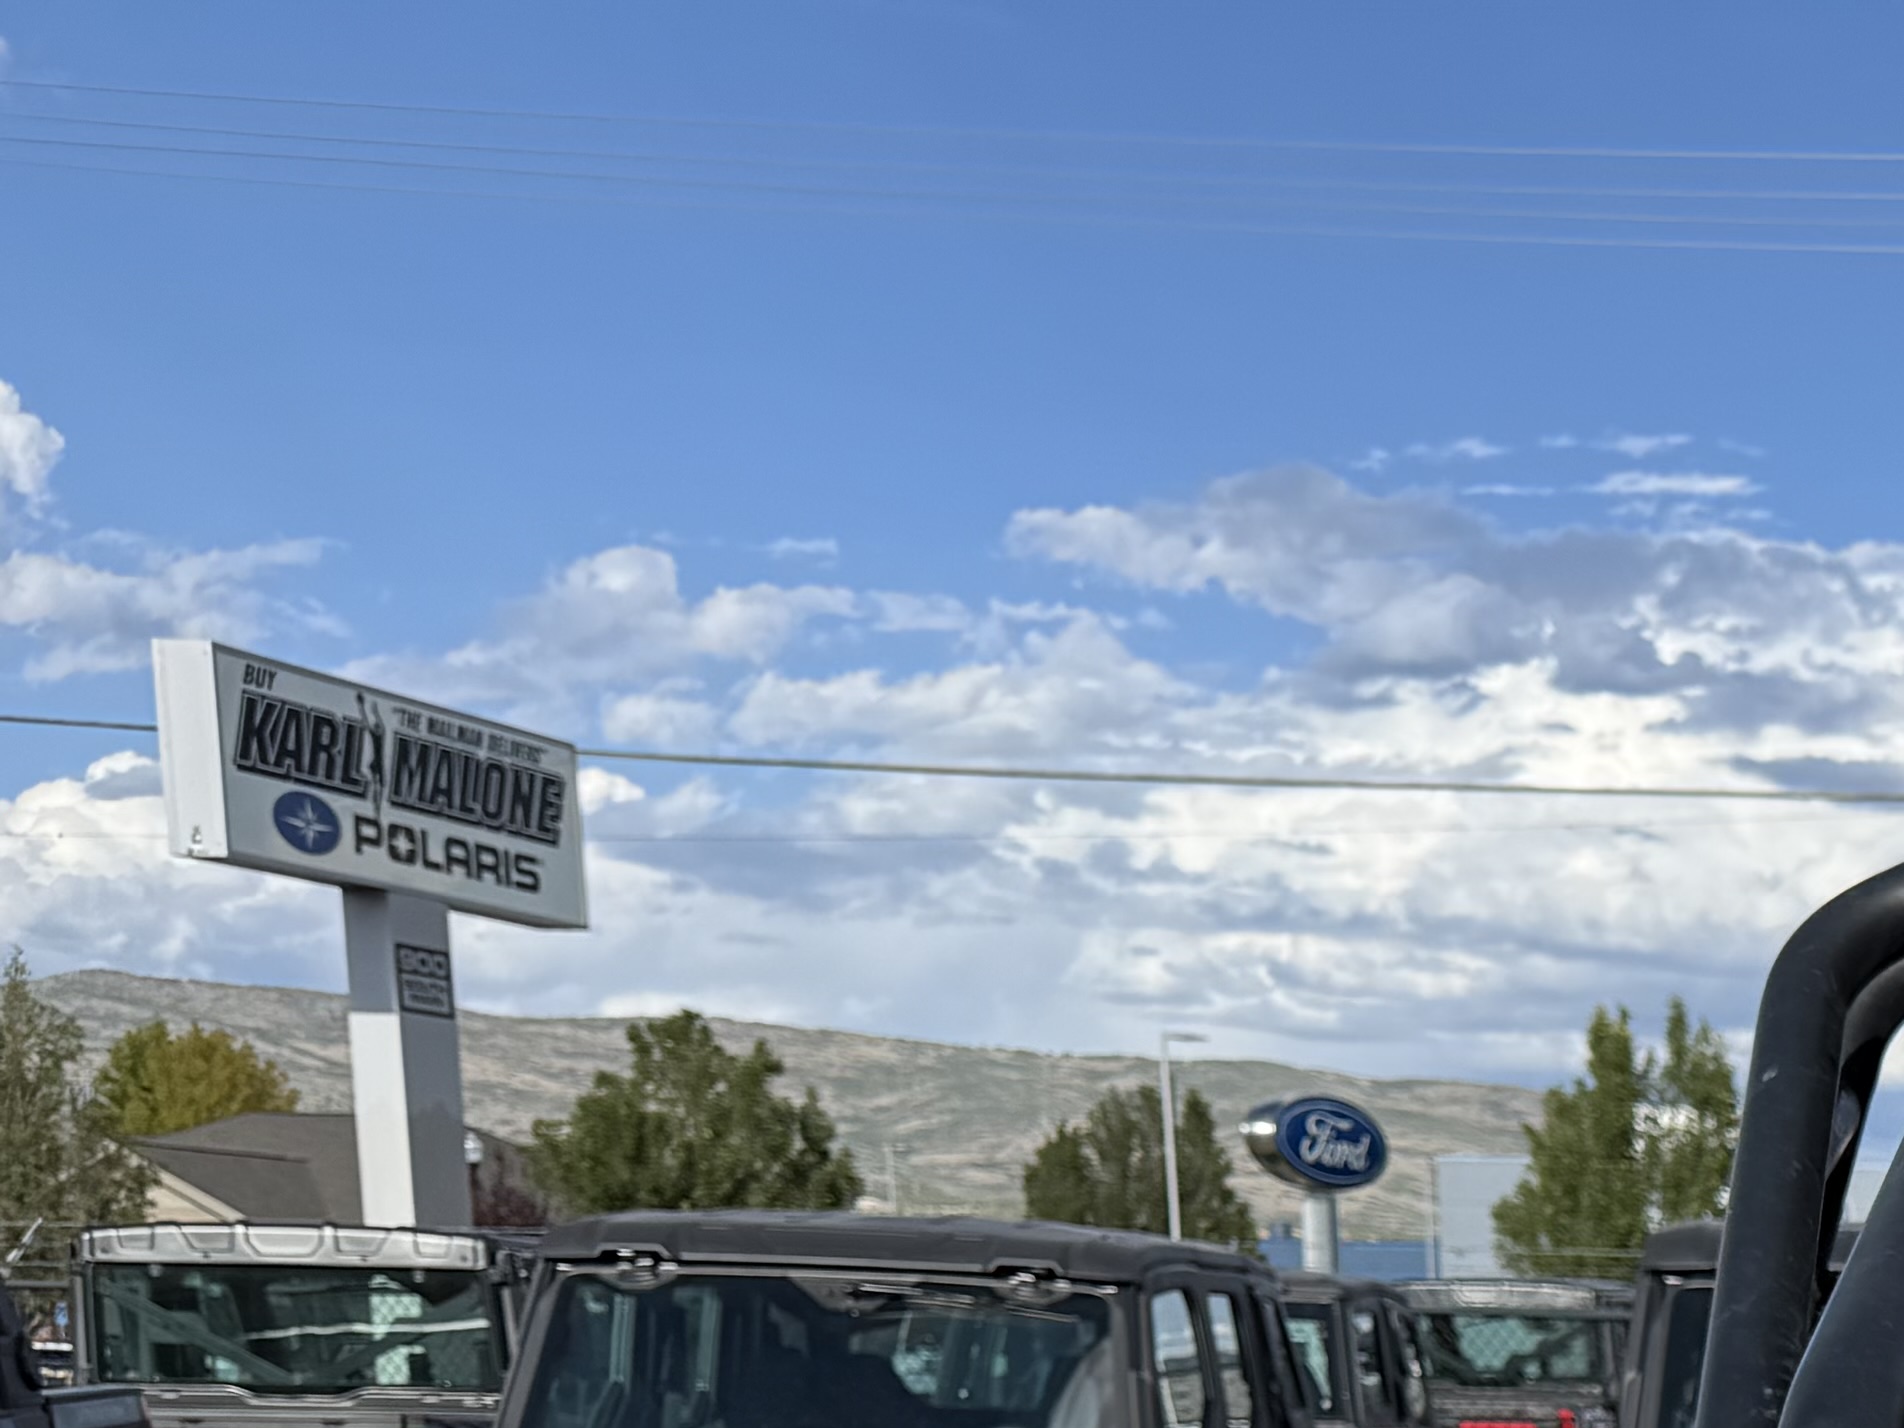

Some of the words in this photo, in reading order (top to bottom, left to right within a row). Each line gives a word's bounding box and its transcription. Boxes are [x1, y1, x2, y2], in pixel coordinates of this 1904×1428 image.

[243, 663, 277, 690] BUY
[235, 690, 368, 797] KARL
[388, 732, 565, 847] MALONE
[354, 813, 540, 893] POLARIS
[1299, 1110, 1371, 1171] Ford
